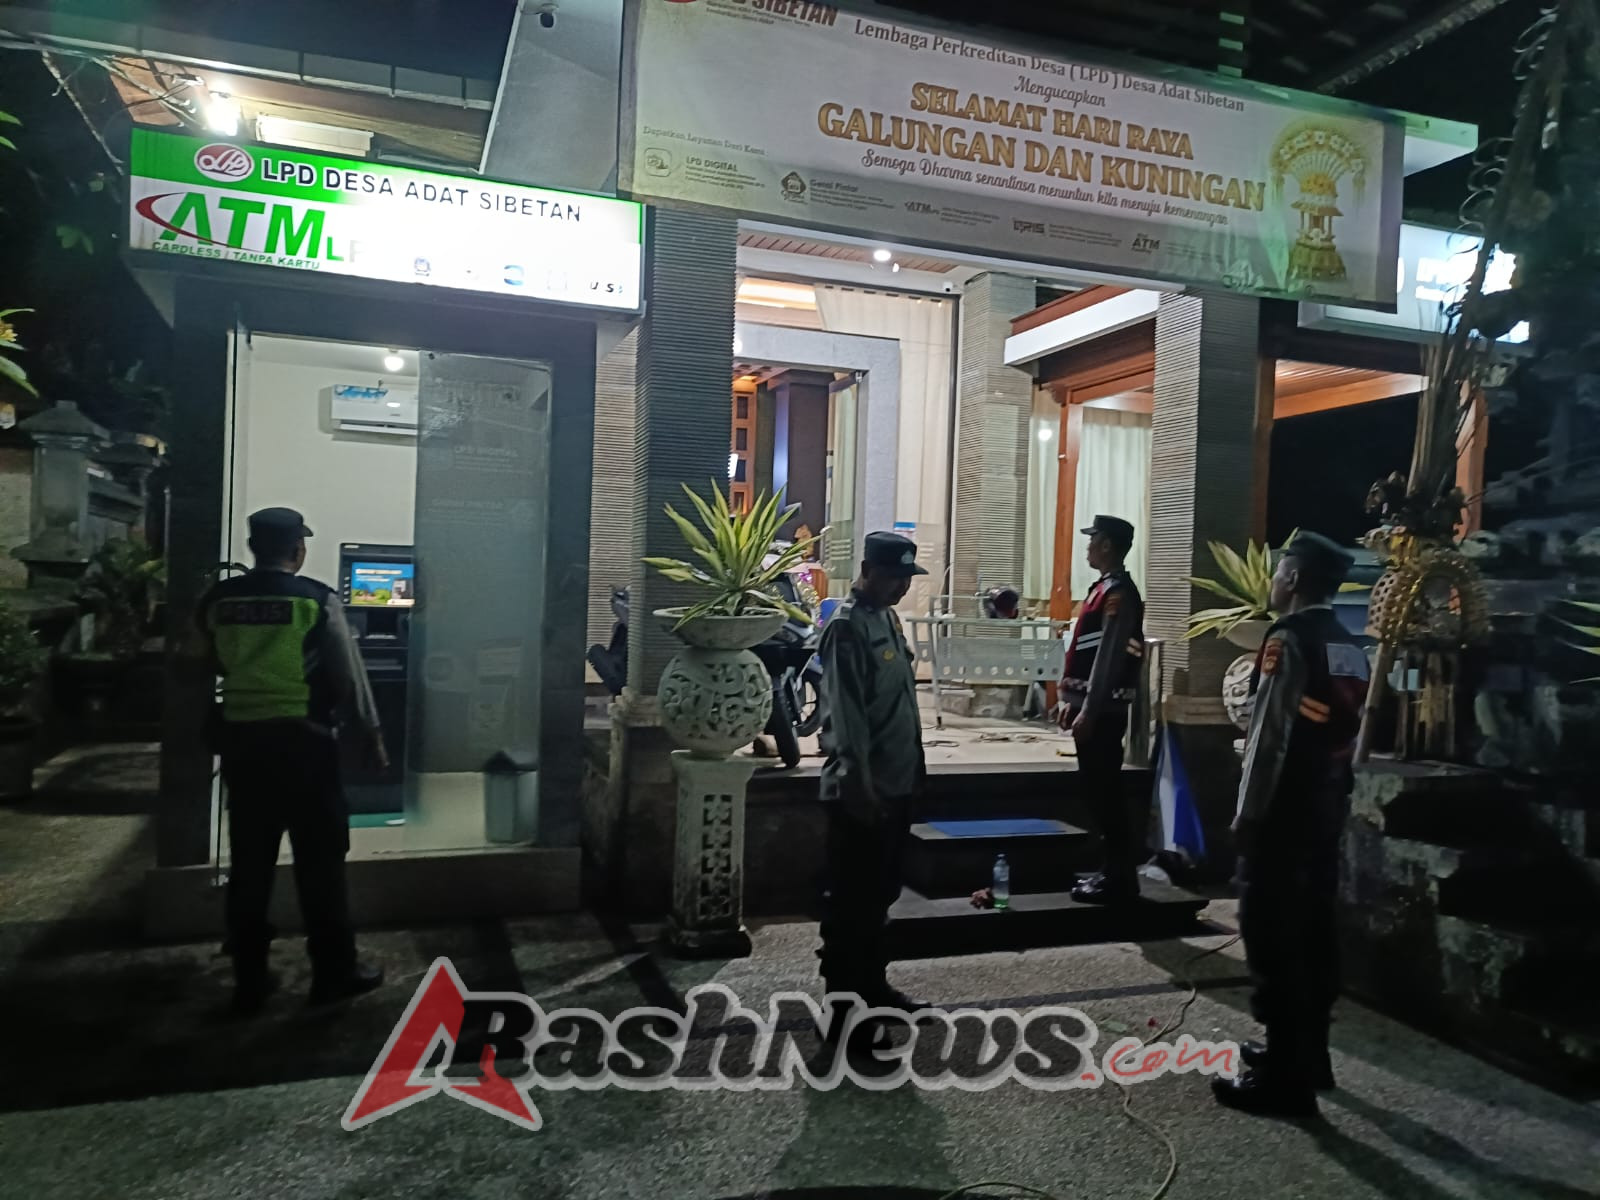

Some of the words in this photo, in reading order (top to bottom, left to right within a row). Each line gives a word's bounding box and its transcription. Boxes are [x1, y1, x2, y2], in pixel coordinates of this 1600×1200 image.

[855, 19, 928, 50] Lembaga
[932, 35, 1027, 68] Perkreditan
[1031, 56, 1066, 76] Desa
[1122, 76, 1156, 94] Desa
[1159, 82, 1191, 101] Adat
[1194, 88, 1245, 112] Sibetan
[1014, 75, 1106, 108] Mengucapkan
[910, 82, 1047, 132] SELAMAT
[1053, 109, 1122, 148] HARI
[1126, 123, 1194, 161] RAYA
[703, 159, 739, 173] DIGITAL
[817, 102, 1017, 169] GALUNGAN
[1023, 140, 1094, 183] DAN
[1100, 155, 1266, 212] KUNINGAN
[861, 148, 916, 176] Semoga
[919, 158, 973, 182] Dharma
[975, 171, 1036, 194] senantiasa
[1037, 184, 1094, 203] menuntun
[1120, 198, 1162, 217] menuju
[1163, 201, 1229, 228] kemenangan
[263, 159, 315, 185] LPD
[325, 169, 394, 196] DESA
[404, 181, 469, 206] ADAT
[479, 192, 581, 222] SIBETAN
[152, 241, 222, 260] CARDLESS
[233, 251, 274, 266] TANPA
[277, 256, 321, 270] KARTU
[159, 191, 326, 259] ATM
[1131, 237, 1161, 250] ATM
